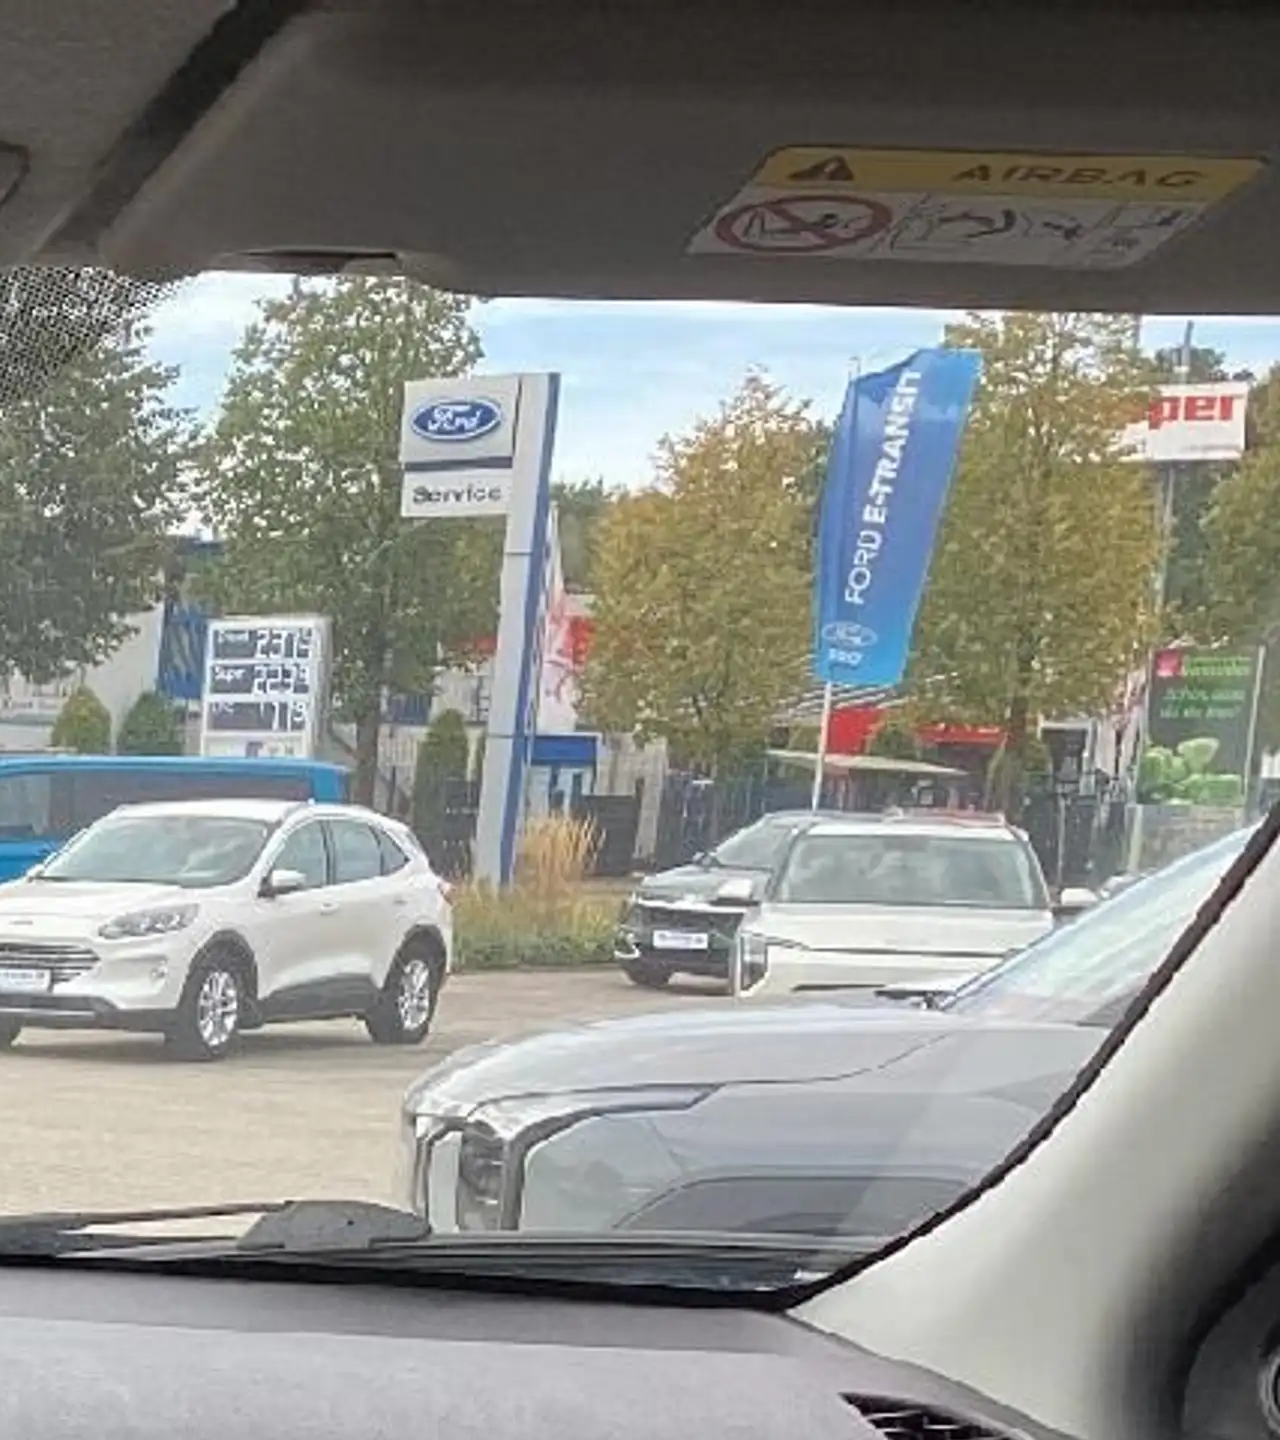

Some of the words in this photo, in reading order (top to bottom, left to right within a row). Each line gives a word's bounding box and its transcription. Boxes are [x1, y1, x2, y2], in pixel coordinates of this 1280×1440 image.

[951, 163, 1207, 188] AIRBAG
[412, 484, 502, 505] Service
[844, 531, 883, 605] FORD
